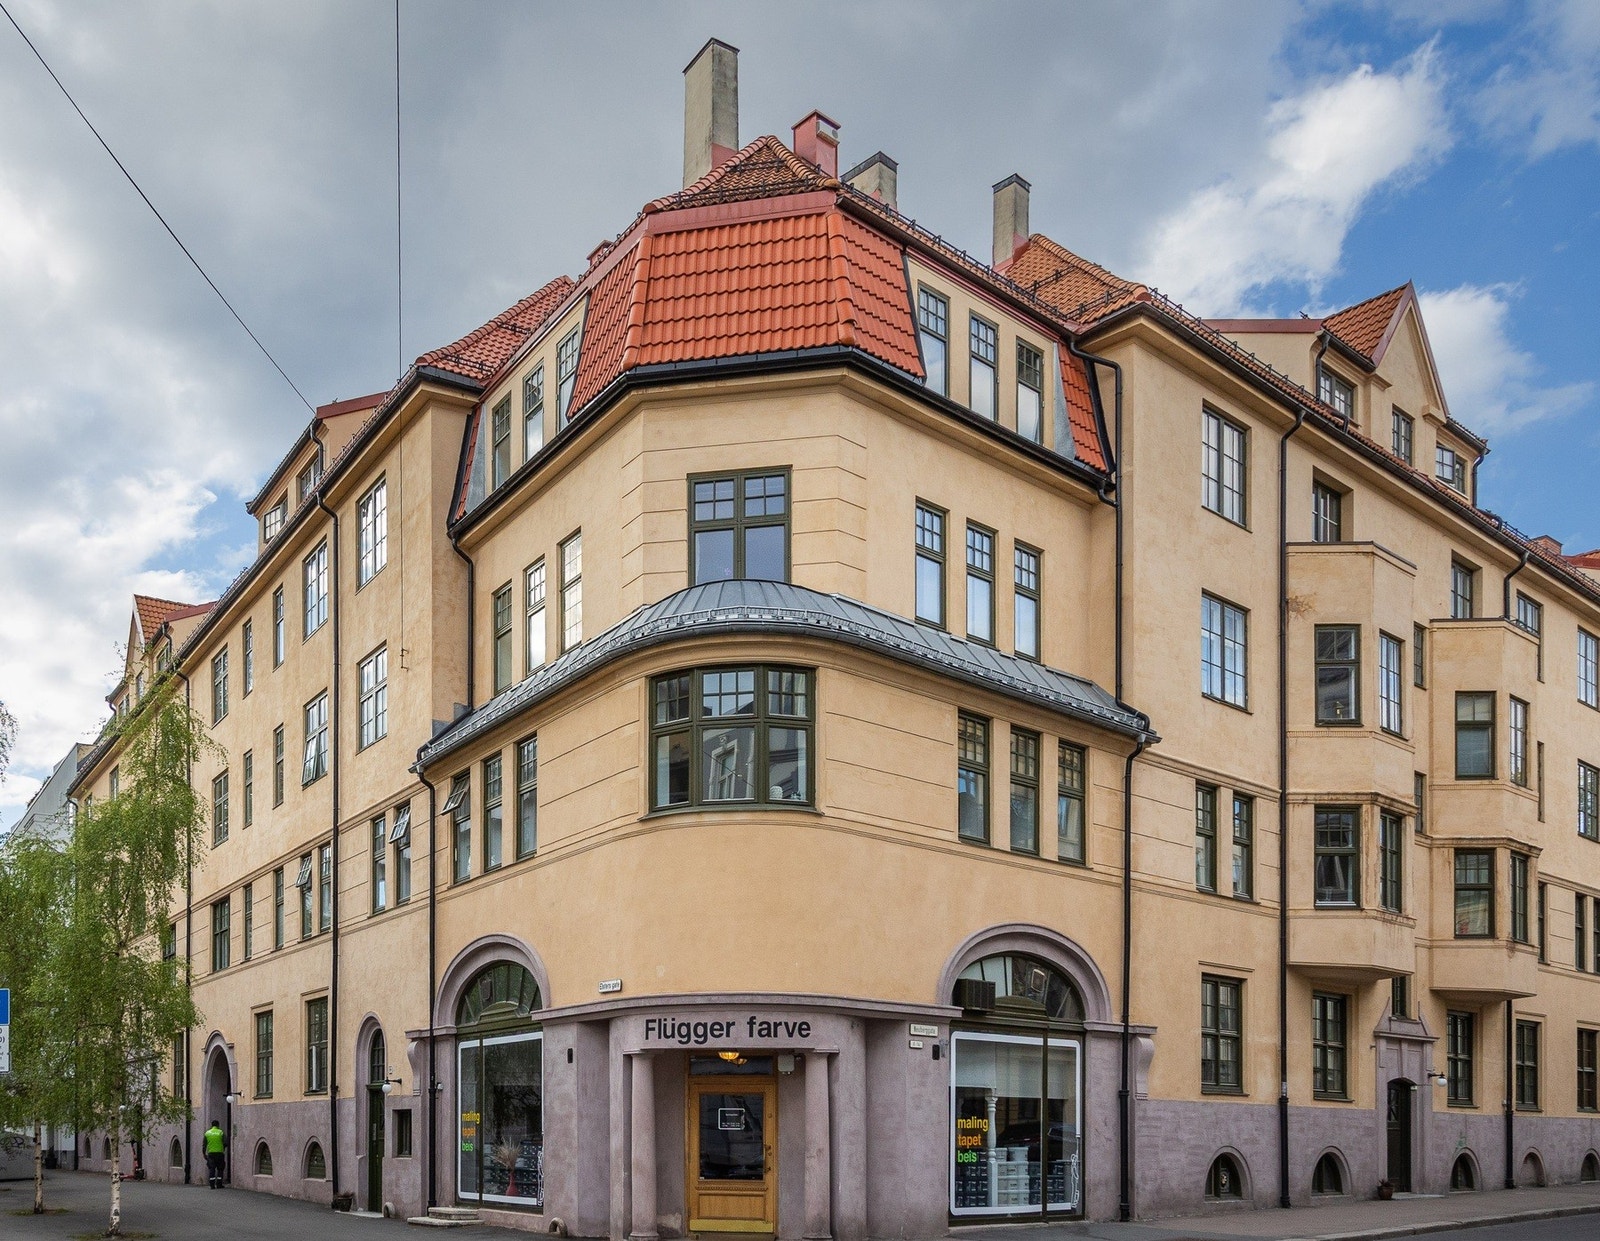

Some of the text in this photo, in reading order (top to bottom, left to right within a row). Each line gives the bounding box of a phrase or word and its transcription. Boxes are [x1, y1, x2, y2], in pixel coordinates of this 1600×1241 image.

[645, 1016, 811, 1045] Flügger farve
[461, 1110, 480, 1124] maling
[957, 1116, 989, 1132] maling
[461, 1126, 476, 1139] tapet
[461, 1140, 474, 1152] beis
[957, 1134, 982, 1149] tapet
[957, 1149, 977, 1163] beis
